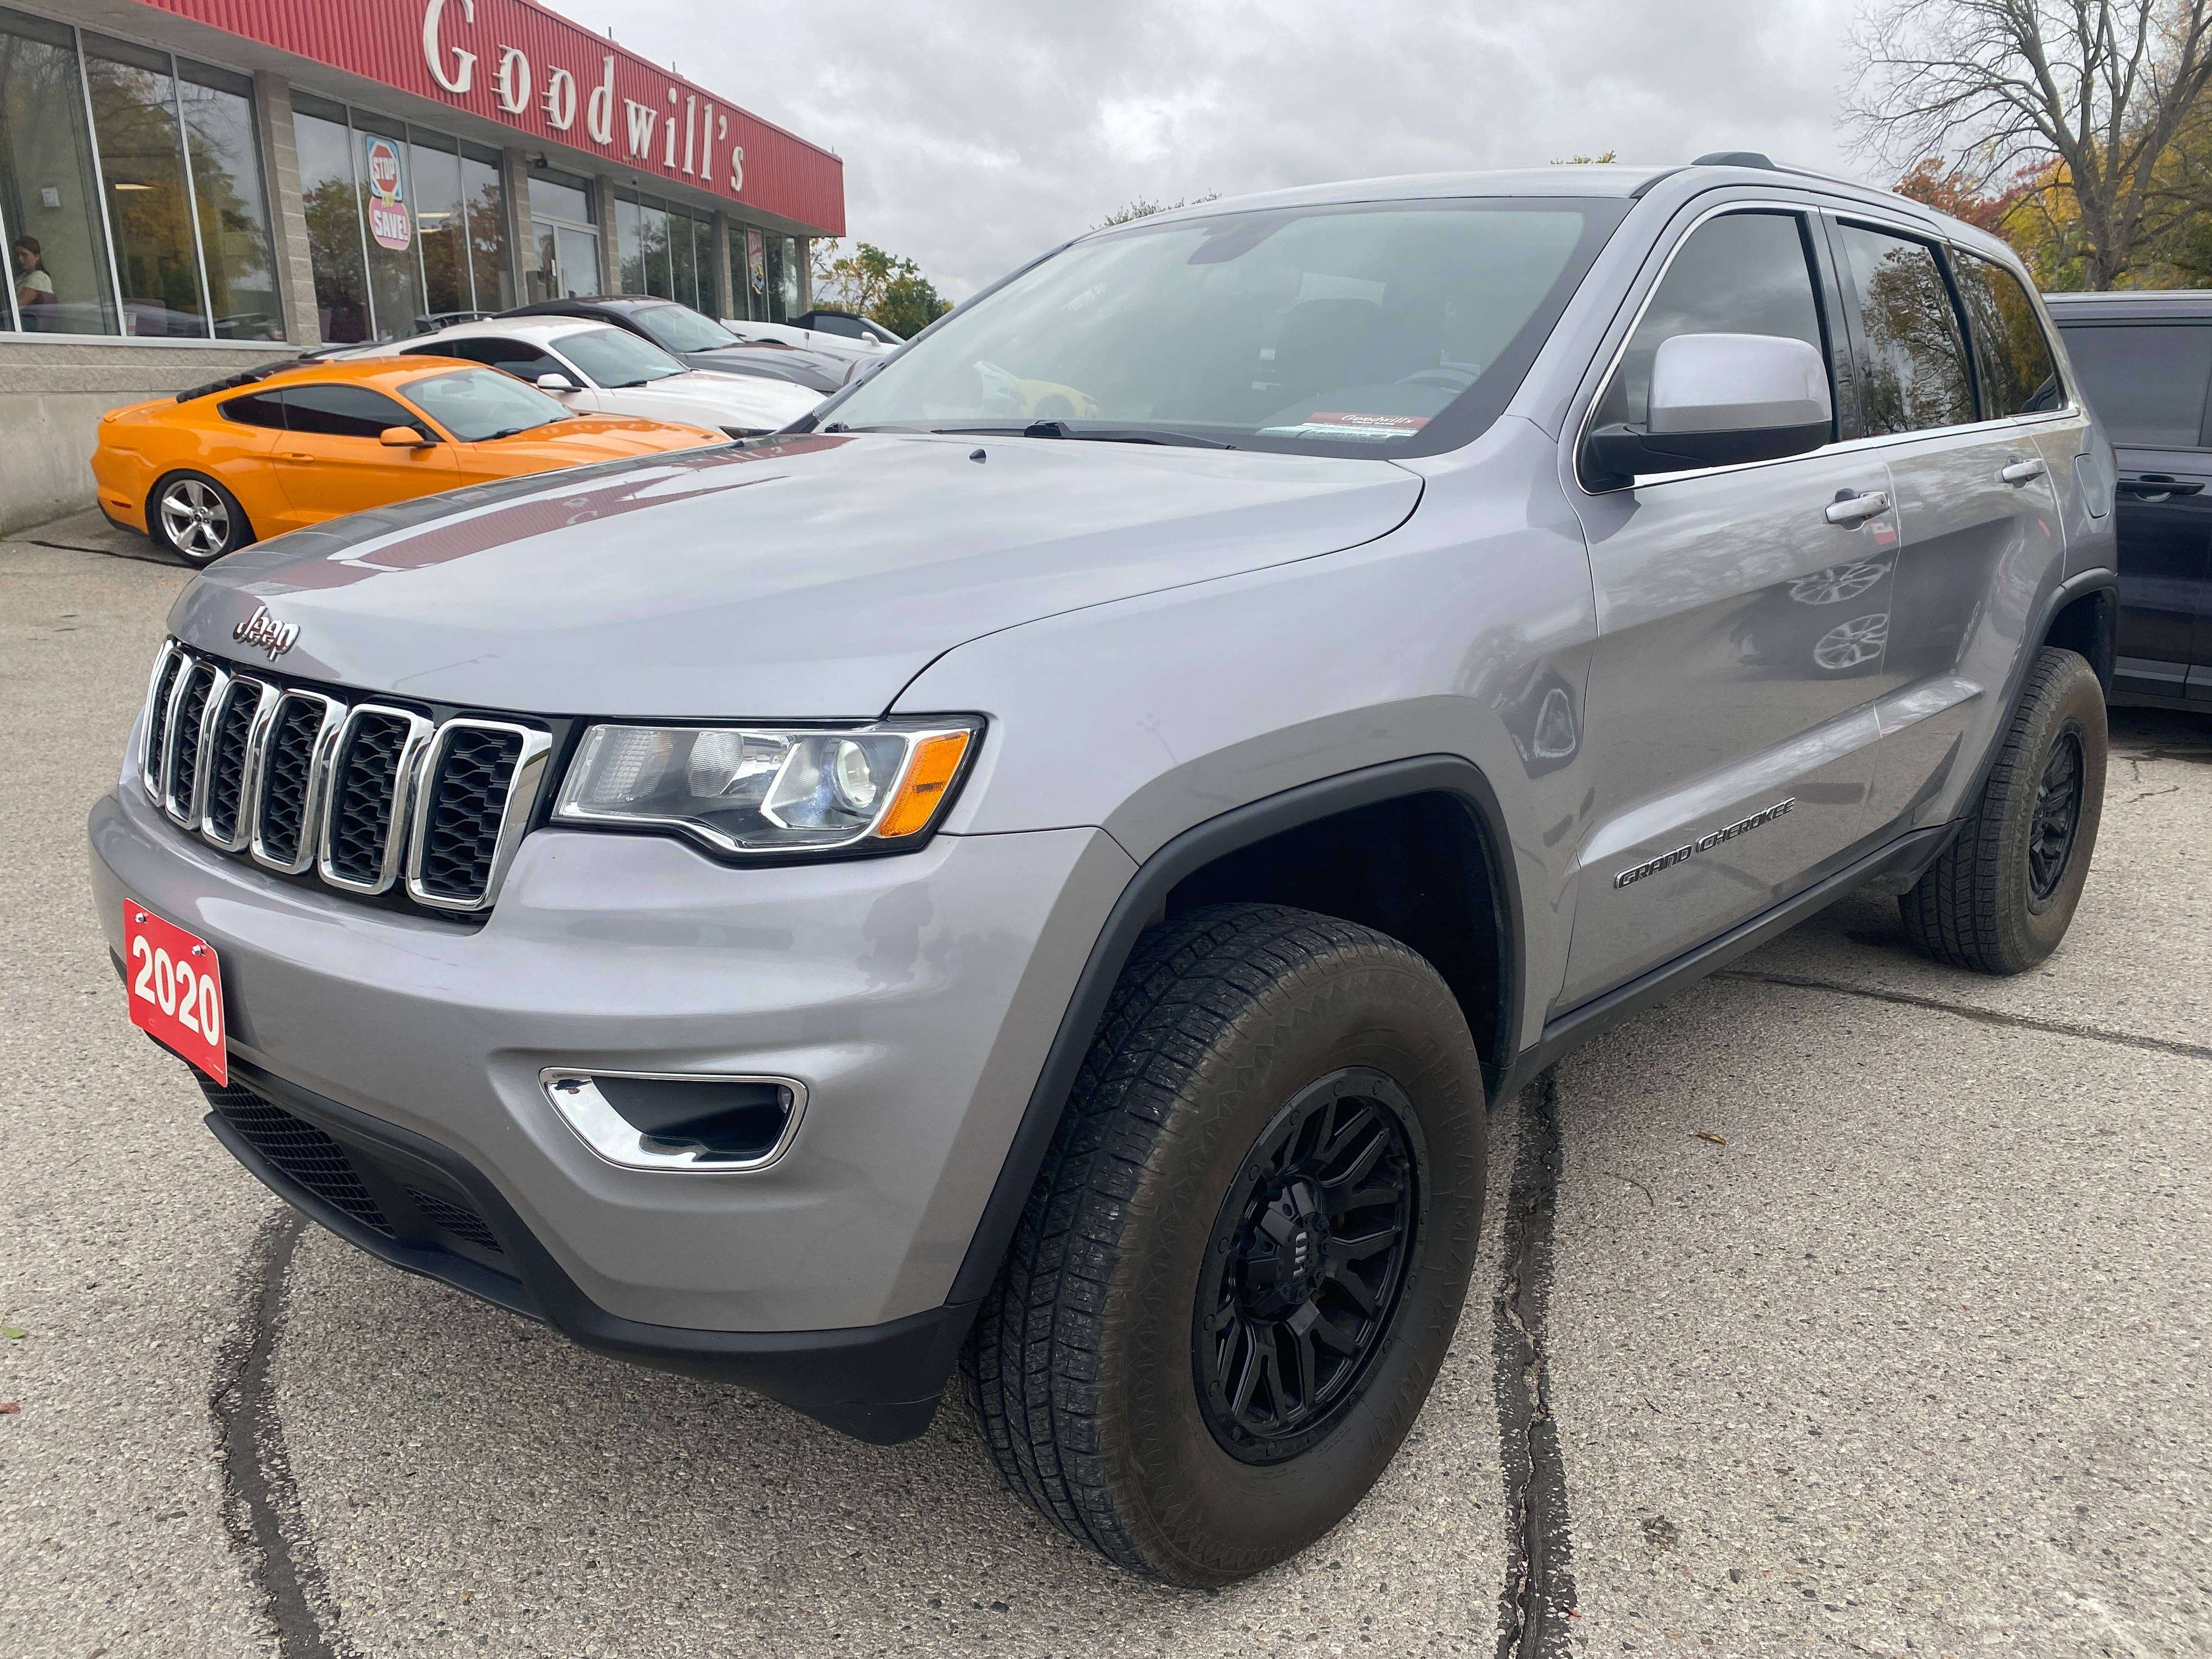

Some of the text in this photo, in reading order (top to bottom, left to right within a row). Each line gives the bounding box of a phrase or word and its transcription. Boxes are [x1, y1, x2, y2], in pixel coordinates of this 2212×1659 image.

[422, 0, 744, 192] Goodwill's
[373, 156, 396, 180] STOP
[373, 209, 409, 241] SAVE!
[1341, 415, 1414, 424] Goodwill's
[233, 605, 301, 662] Jeep
[1614, 797, 1796, 889] GRAND CHEROKEE
[132, 935, 219, 1047] 2020
